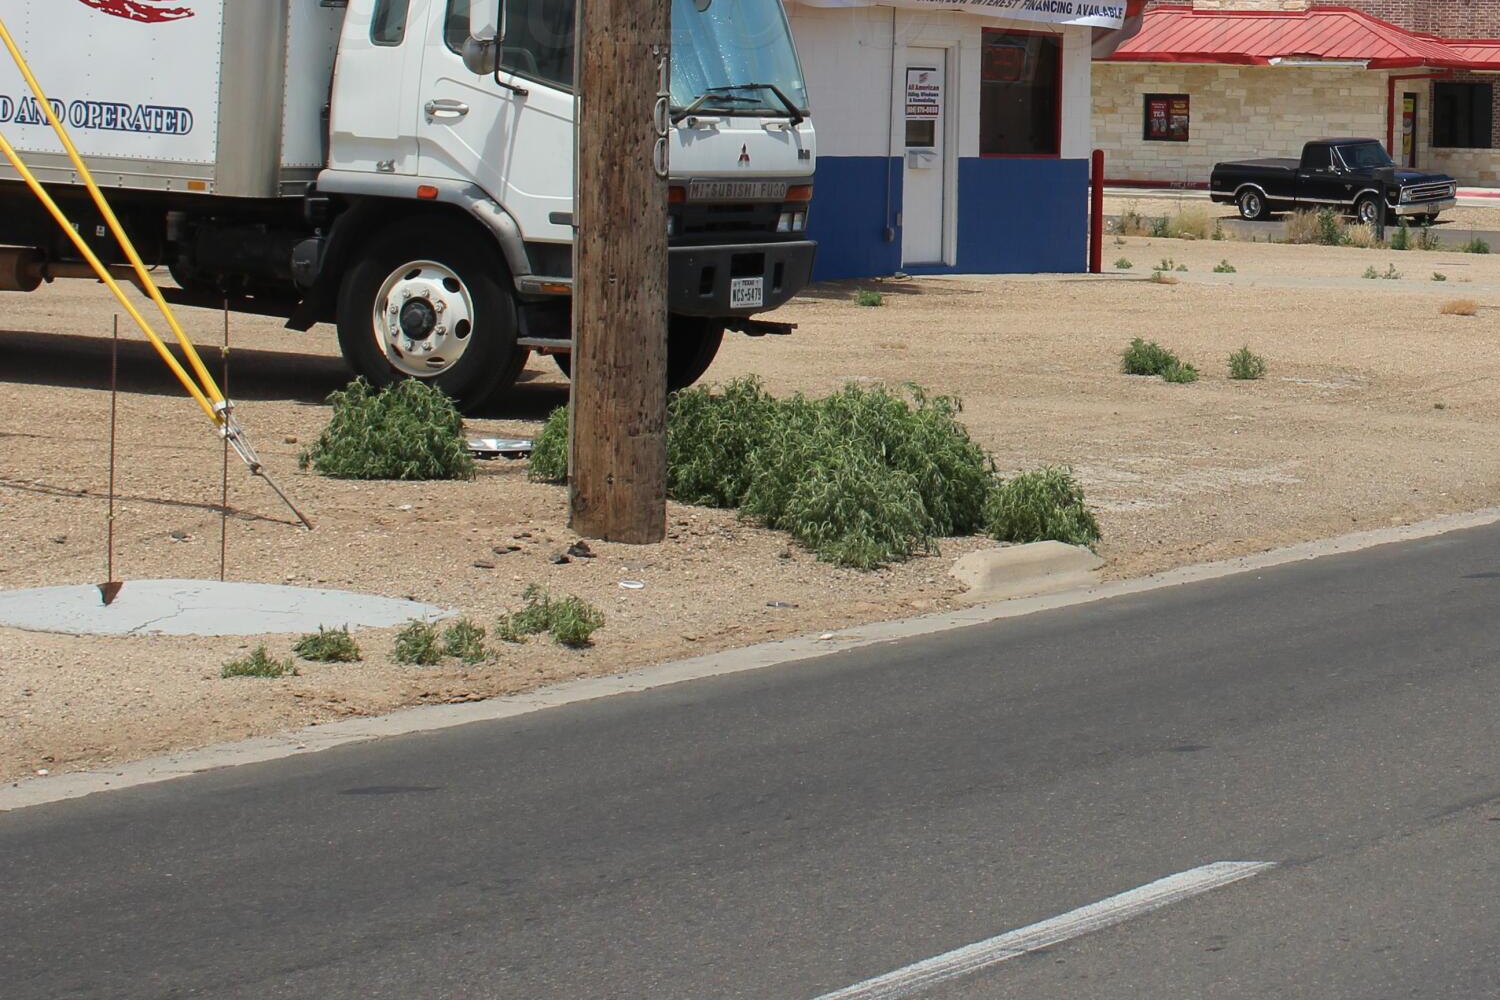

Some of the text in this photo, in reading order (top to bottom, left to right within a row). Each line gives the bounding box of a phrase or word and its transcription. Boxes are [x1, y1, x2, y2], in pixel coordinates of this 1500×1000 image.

[1021, 0, 1073, 14] FINANCING
[1075, 3, 1124, 20] AVAILABLE
[15, 96, 66, 126] AND
[69, 100, 194, 135] OPERATED
